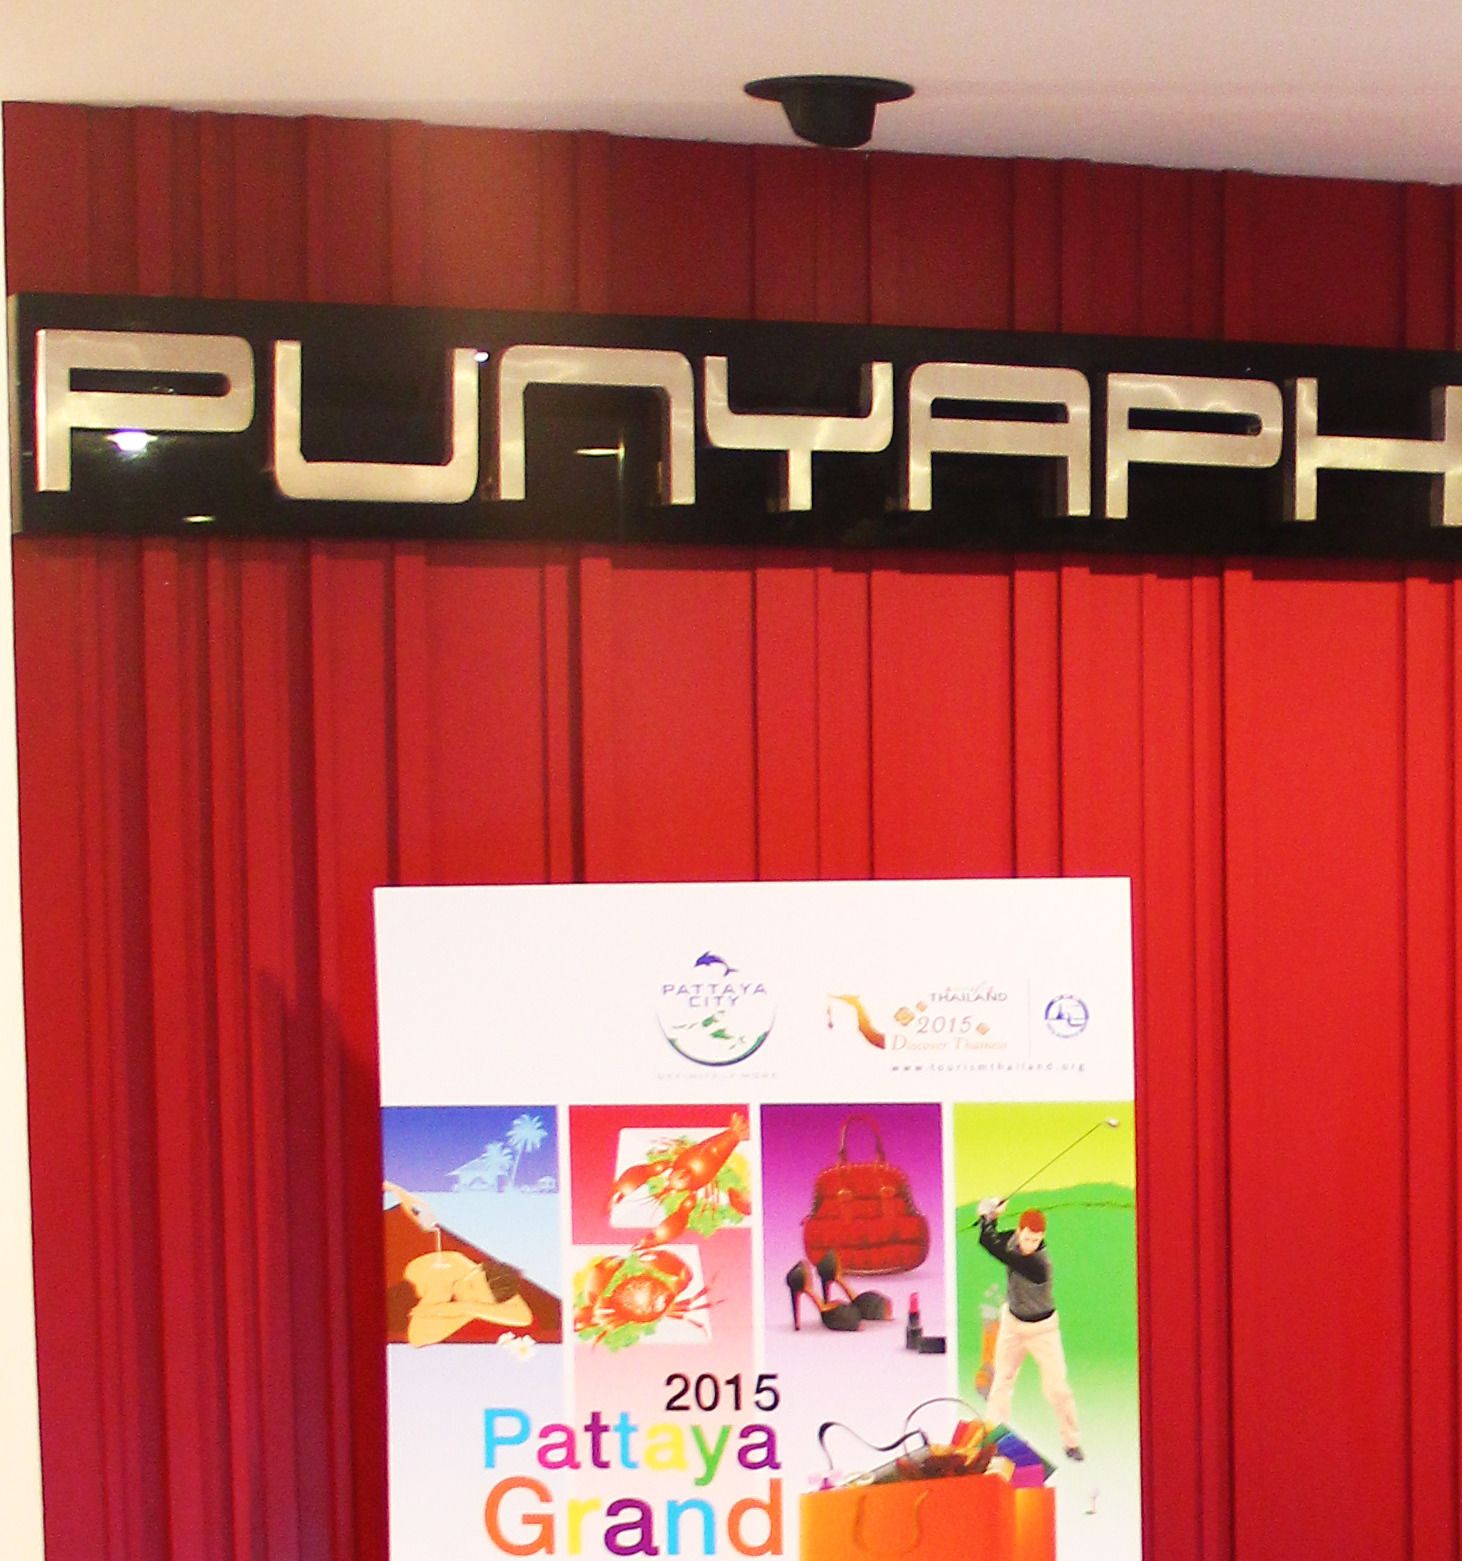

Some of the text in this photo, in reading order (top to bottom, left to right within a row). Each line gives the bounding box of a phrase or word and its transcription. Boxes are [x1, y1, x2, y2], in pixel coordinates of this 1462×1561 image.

[661, 982, 768, 996] PATTAYA
[688, 996, 740, 1008] CITY
[916, 1015, 973, 1034] 2015
[664, 1373, 780, 1413] 2015
[483, 1407, 781, 1486] Pattaya
[484, 1475, 784, 1558] Grand
